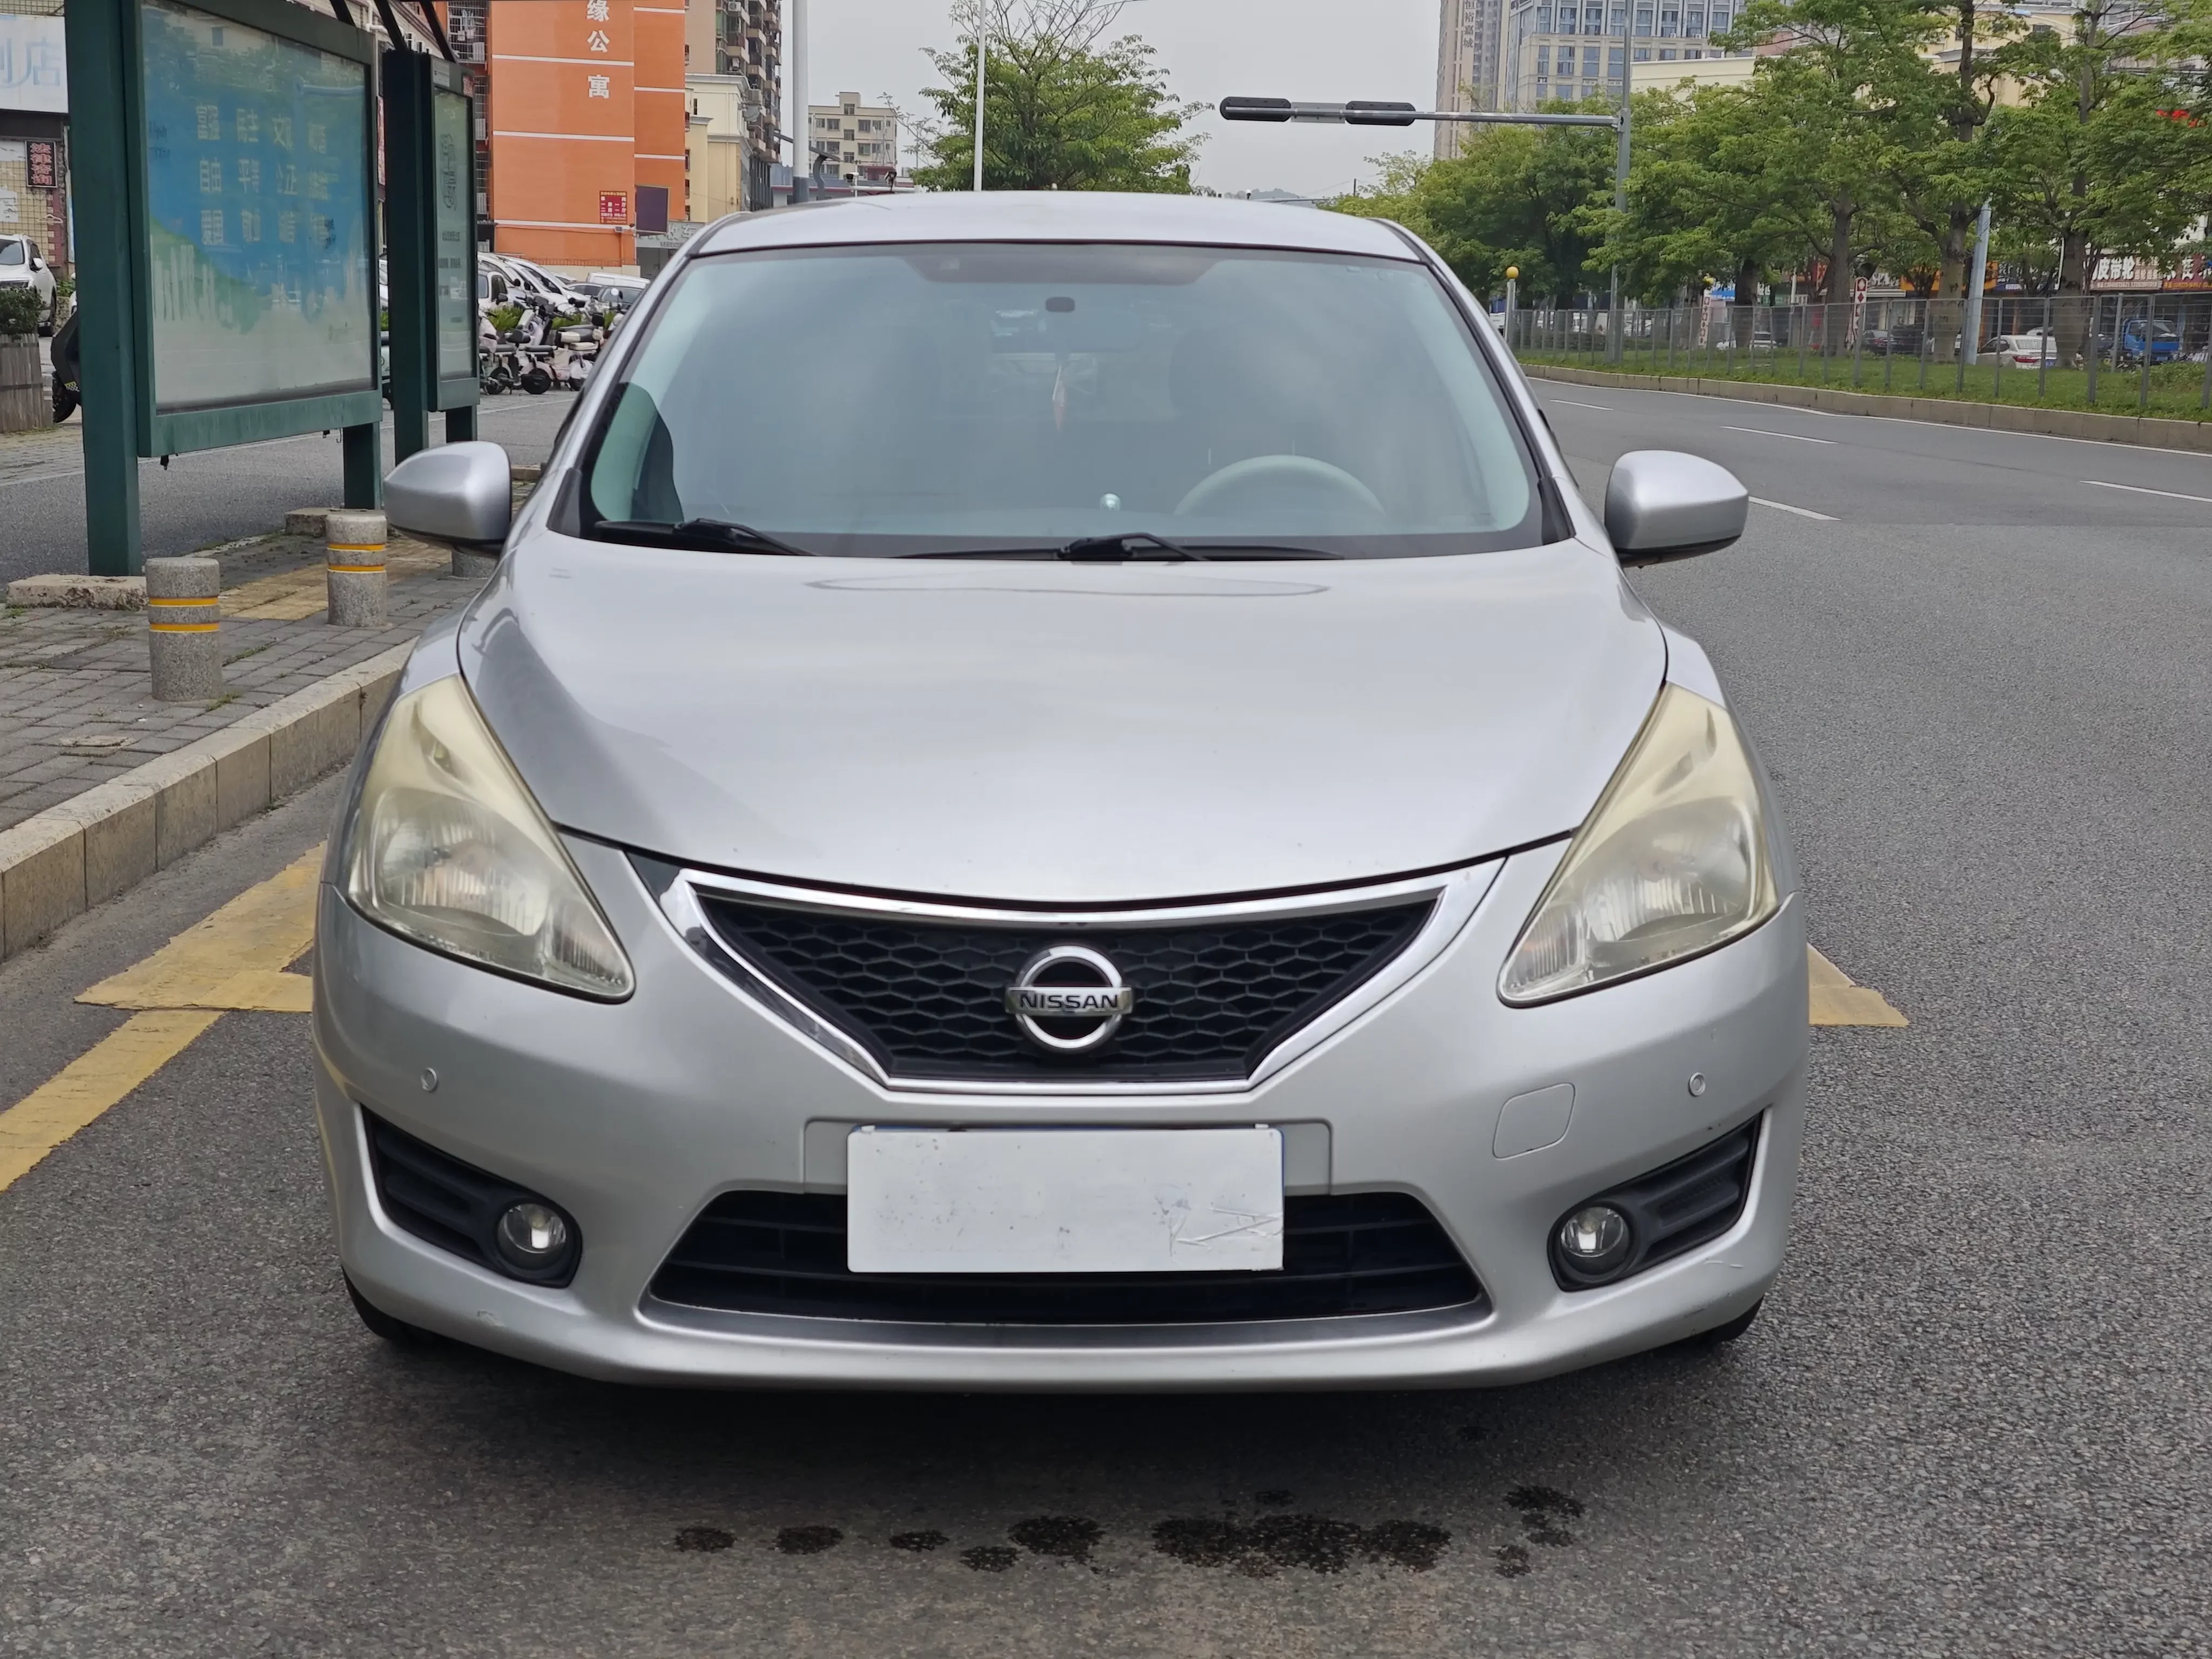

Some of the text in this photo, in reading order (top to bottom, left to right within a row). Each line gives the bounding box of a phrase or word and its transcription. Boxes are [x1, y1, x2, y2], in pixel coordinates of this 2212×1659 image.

[586, 0, 610, 98] 缘公寓
[29, 142, 52, 185] 法律咨询
[2092, 255, 2136, 280] 皮带轮
[1020, 994, 1118, 1009] NISSAN
